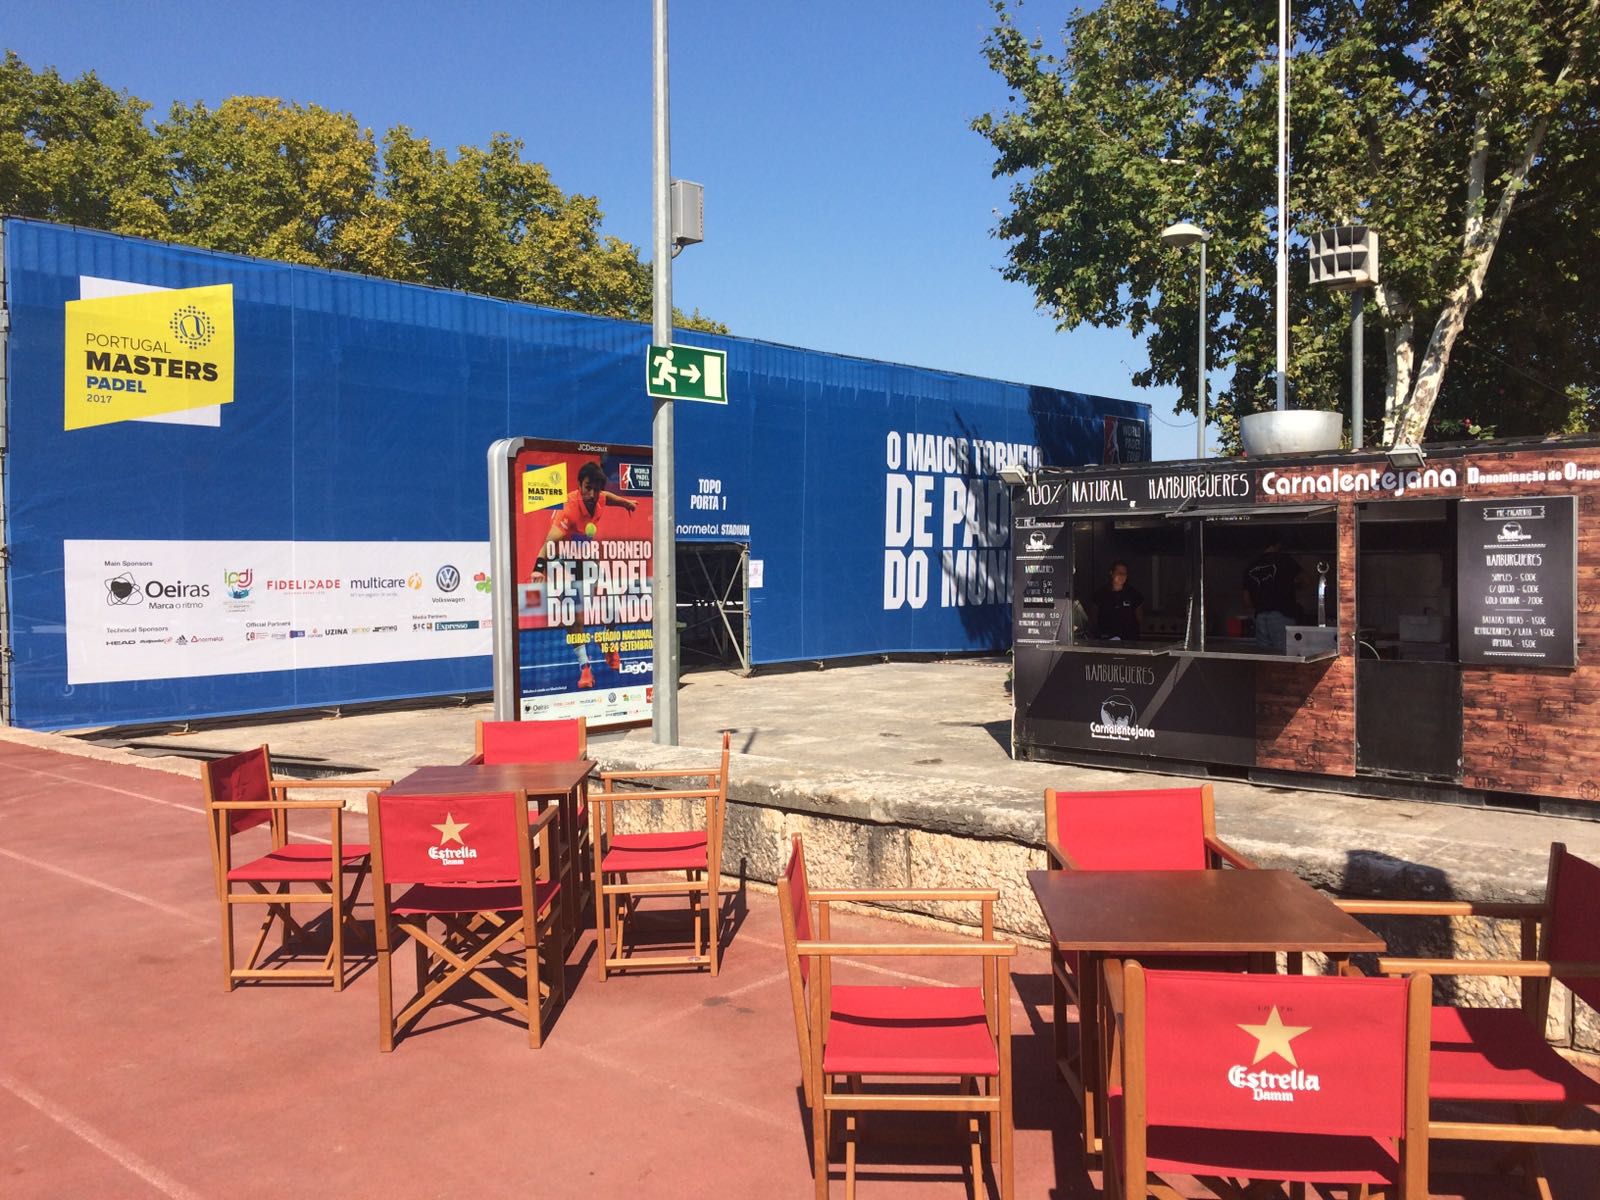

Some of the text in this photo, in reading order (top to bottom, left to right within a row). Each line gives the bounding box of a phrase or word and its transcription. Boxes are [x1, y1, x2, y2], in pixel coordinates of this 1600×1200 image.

[86, 332, 172, 354] PORTUGAL
[85, 350, 219, 381] MASTERS
[87, 376, 148, 393] PADEL
[87, 394, 113, 404] 2017
[577, 443, 608, 453] JCDecaux
[886, 431, 1044, 477] O MAIOR TORNEIO
[633, 467, 650, 475] WORLD
[638, 480, 650, 488] TOUR
[698, 479, 722, 495] TOPO
[1025, 472, 1249, 507] 100% NATURAL HAMBURGUERES
[1261, 467, 1458, 497] Carnalentejana
[527, 487, 564, 496] MASTERS
[690, 495, 728, 510] PORTA 1
[885, 472, 1011, 548] DE PAD
[675, 524, 750, 536] normetal STADIUM
[546, 540, 653, 560] O MAIOR TORNEIO
[104, 560, 153, 569] Main Sponsors
[1486, 553, 1543, 567] HAMBURGUERES
[266, 579, 341, 590] FIDELIDADE
[350, 577, 406, 589] multicare
[547, 560, 654, 597] DE PADEL
[883, 549, 1013, 610] DO MUN
[145, 580, 210, 598] Oeiras
[149, 602, 175, 610] Marca
[182, 602, 204, 610] ritmo
[432, 596, 466, 604] Volkswagen
[547, 595, 654, 628] DO MUNDO
[107, 625, 169, 634] Technical Sponsors
[246, 621, 267, 629] Official
[325, 628, 349, 636] UZINA
[436, 622, 469, 631] Expresso
[566, 632, 592, 645] OEIRAS
[622, 628, 654, 642] NACIONAL
[620, 638, 654, 652] SETEMBRO
[1084, 663, 1156, 686] HAMBURGUERES
[1089, 722, 1156, 739] Carnalentejana
[427, 845, 479, 860] Estrella
[1227, 1064, 1322, 1092] Estrella
[1253, 1087, 1295, 1102] Damm
